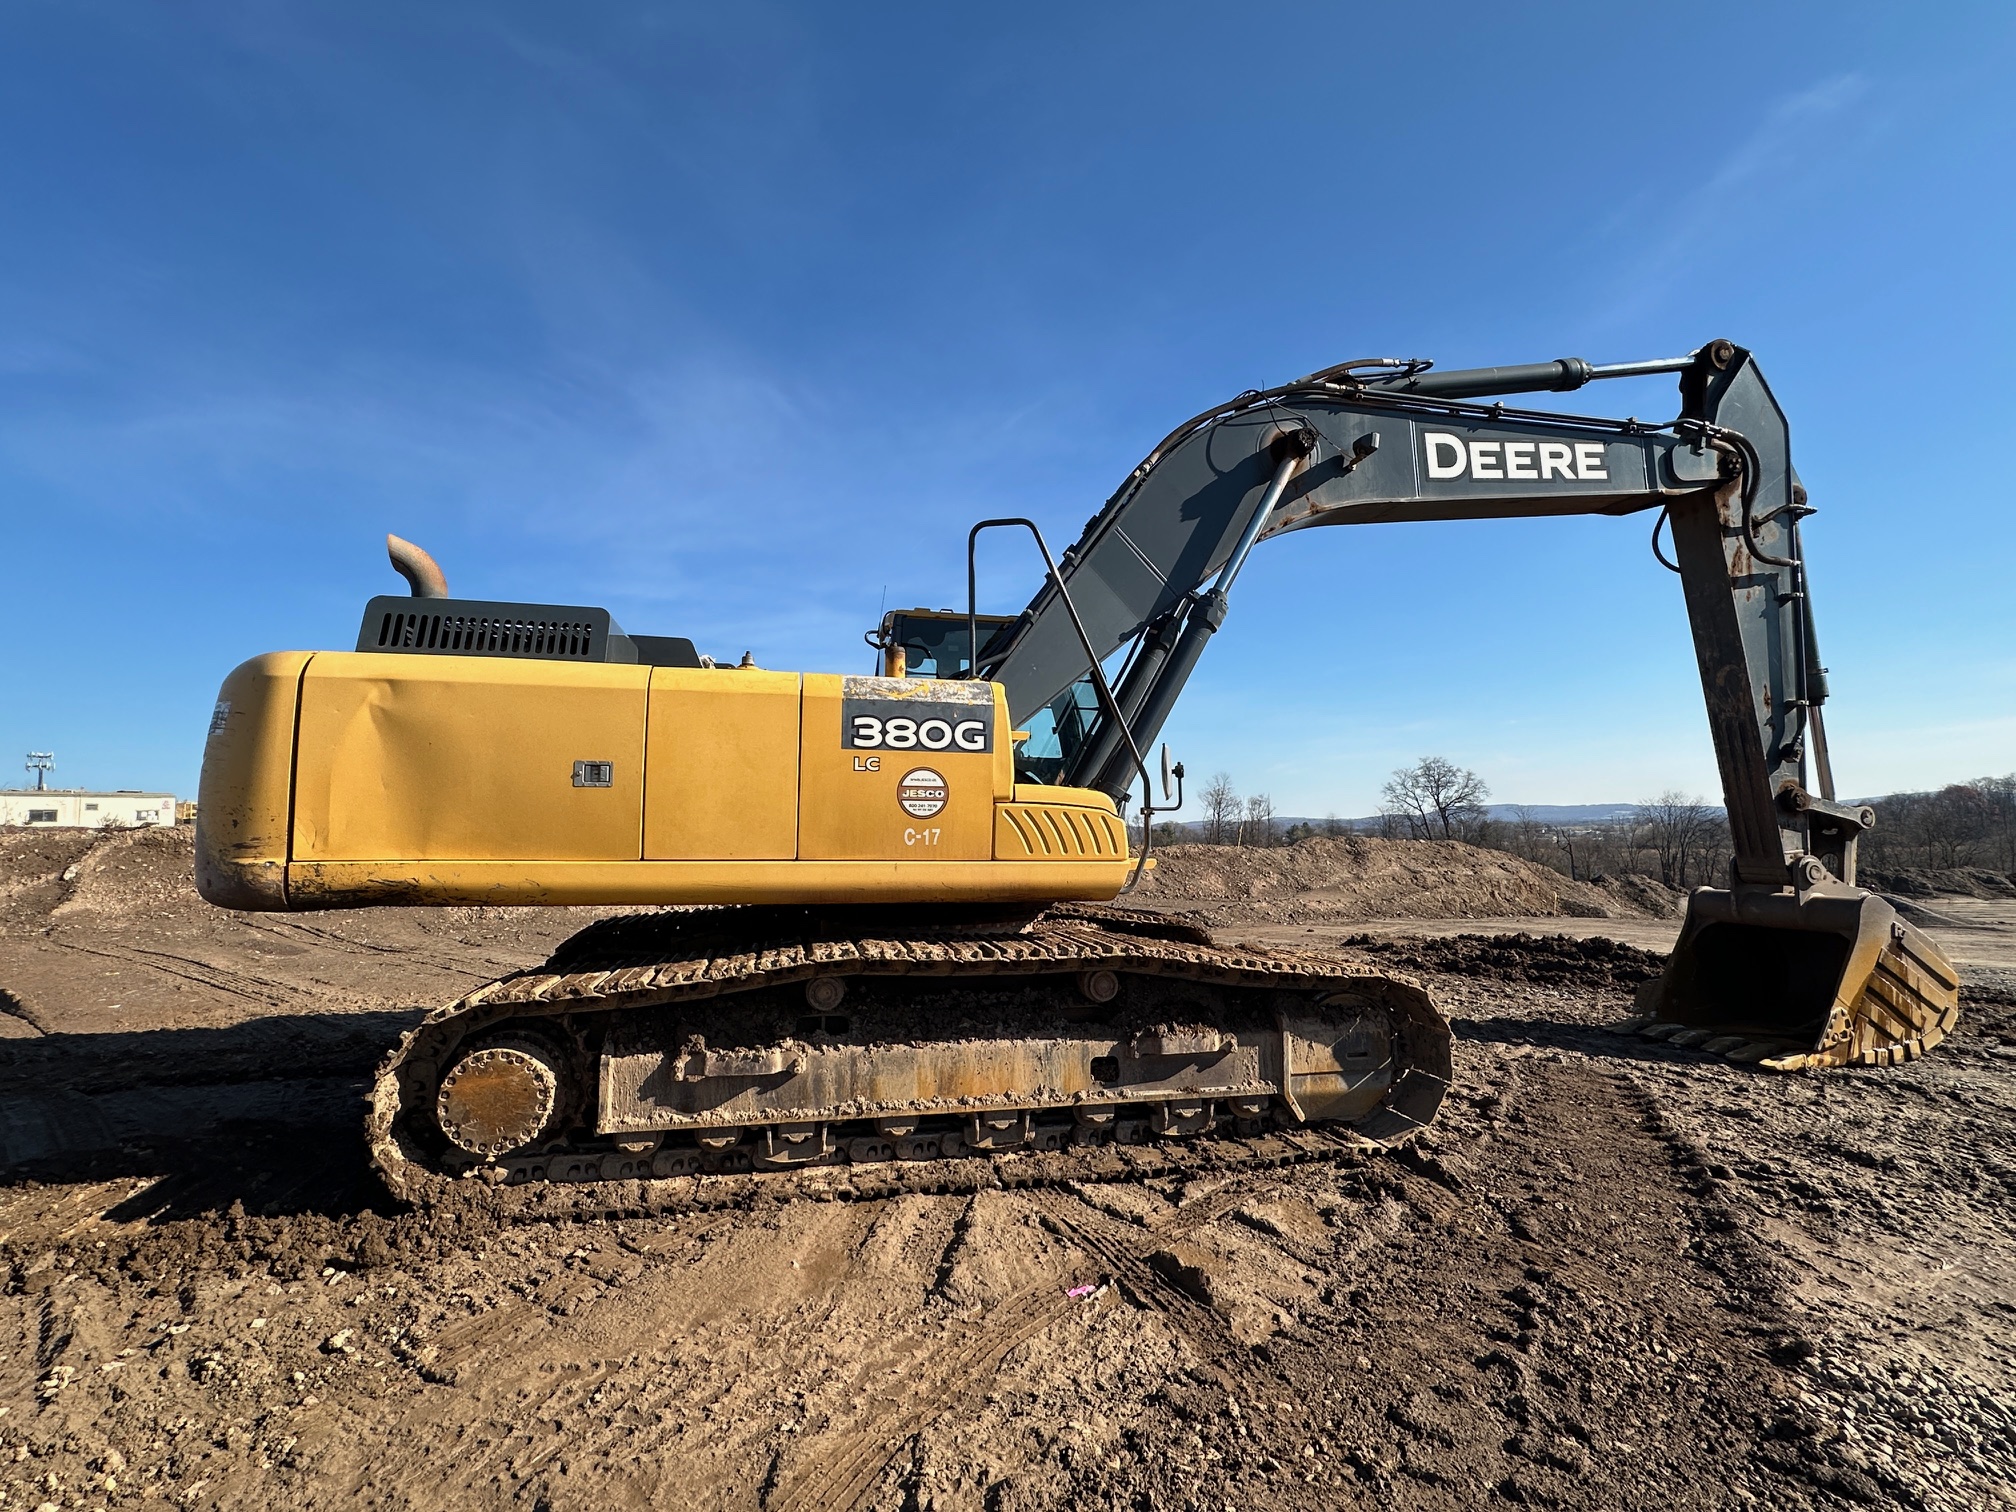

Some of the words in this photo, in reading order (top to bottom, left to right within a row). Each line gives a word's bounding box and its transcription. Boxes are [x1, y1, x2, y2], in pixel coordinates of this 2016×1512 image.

[1424, 432, 1608, 479] DEERE
[853, 716, 985, 749] 380G
[853, 756, 880, 772] LC
[902, 789, 945, 798] JESCO
[904, 828, 941, 846] C-17
